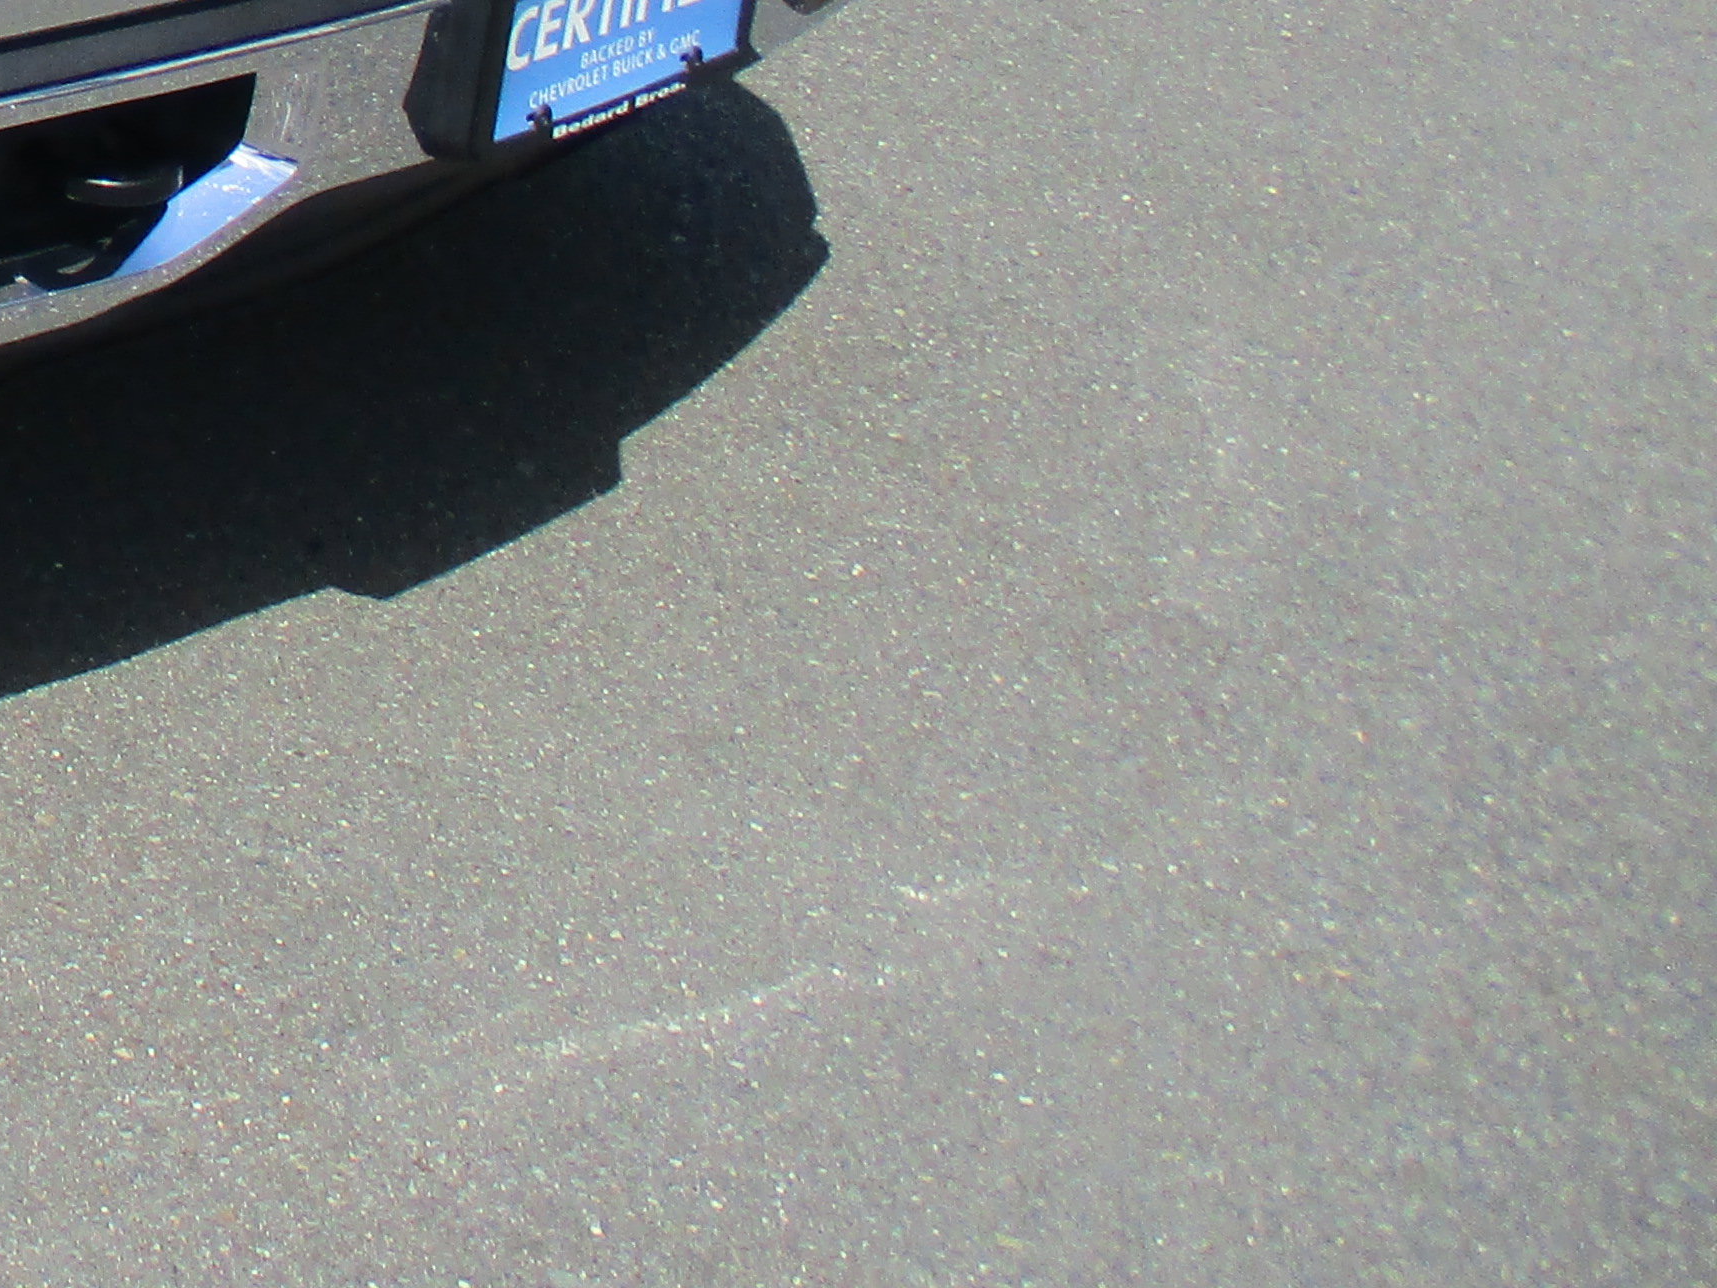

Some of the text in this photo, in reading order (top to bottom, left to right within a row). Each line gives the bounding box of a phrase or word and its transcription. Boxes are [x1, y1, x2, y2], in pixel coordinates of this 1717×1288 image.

[529, 28, 702, 109] CHEVROLET BUICK & GMC
[580, 26, 656, 69] BACKED BY
[552, 100, 630, 140] Bedard
